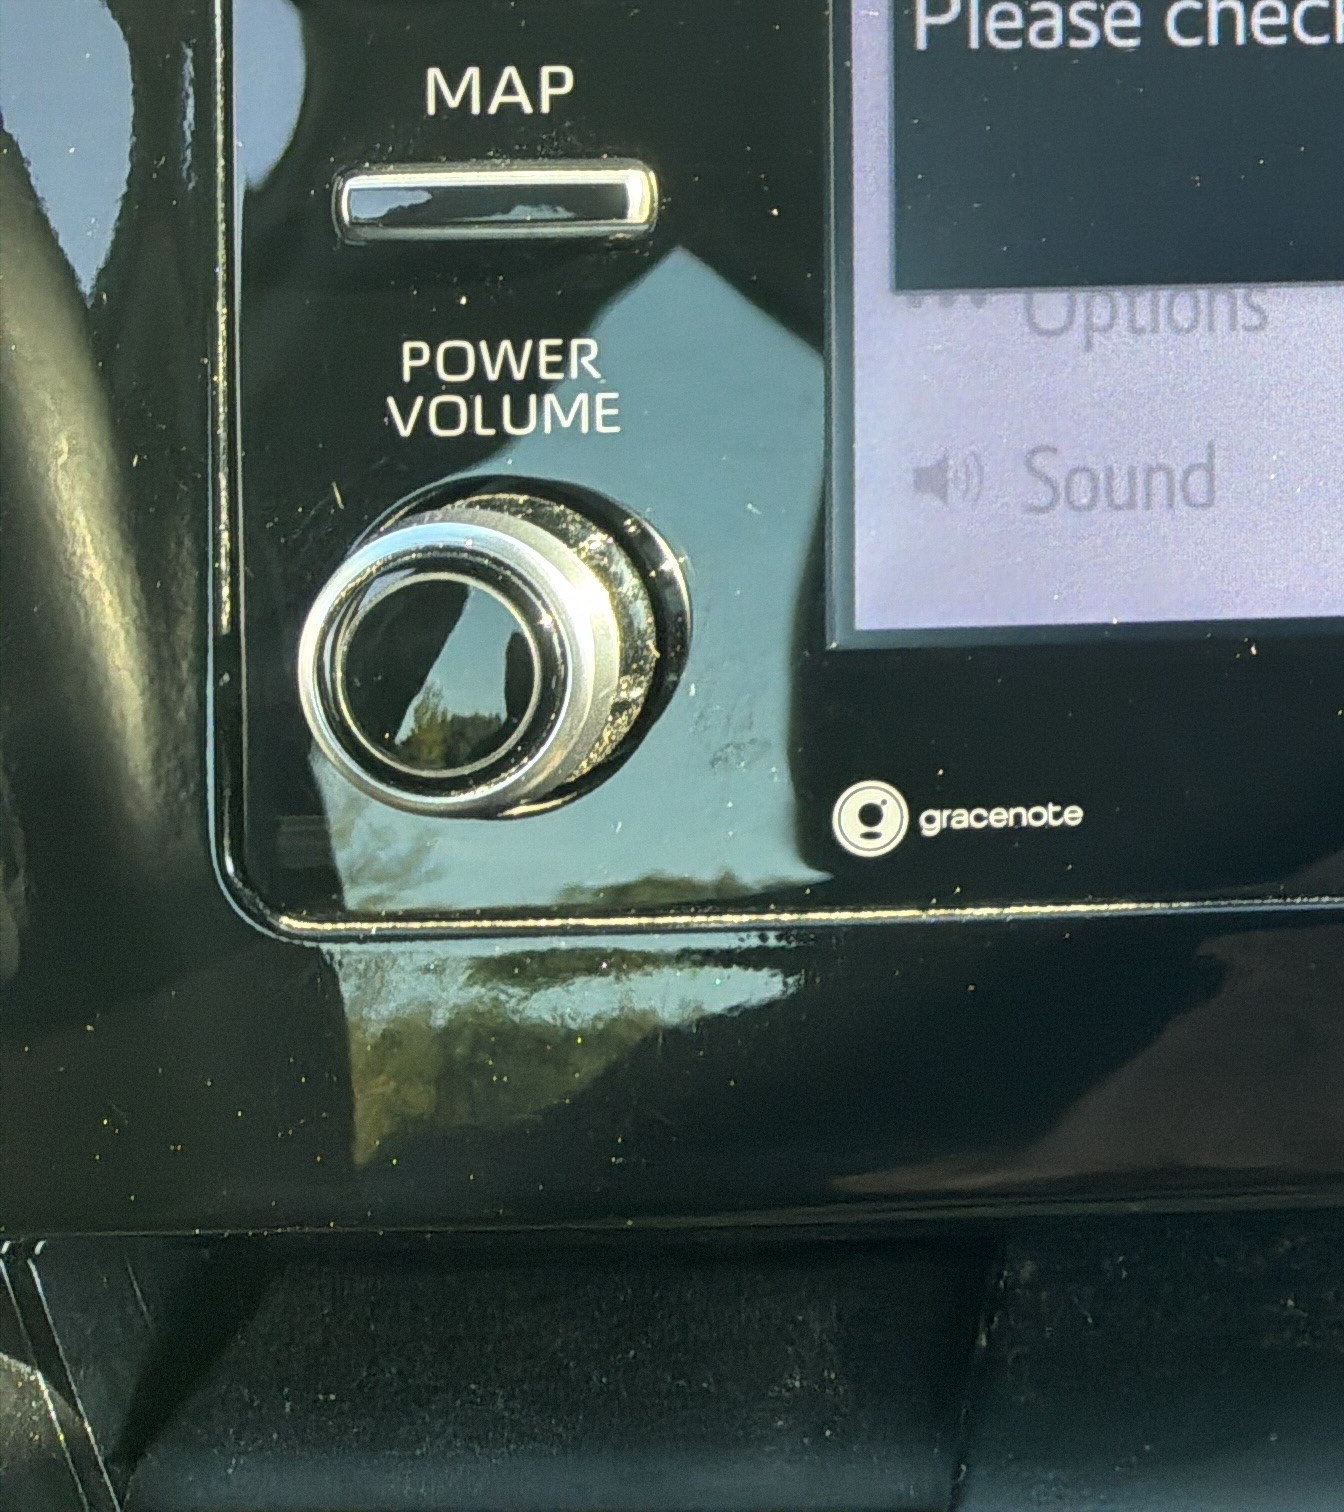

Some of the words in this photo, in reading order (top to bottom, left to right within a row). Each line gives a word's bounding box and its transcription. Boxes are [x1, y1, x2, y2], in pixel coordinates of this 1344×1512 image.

[425, 65, 575, 116] MAP
[1022, 288, 1270, 352] Options
[401, 338, 601, 383] POWER
[387, 389, 624, 439] VOLUME
[1022, 440, 1218, 517] Sound
[918, 802, 1085, 838] gracenote
